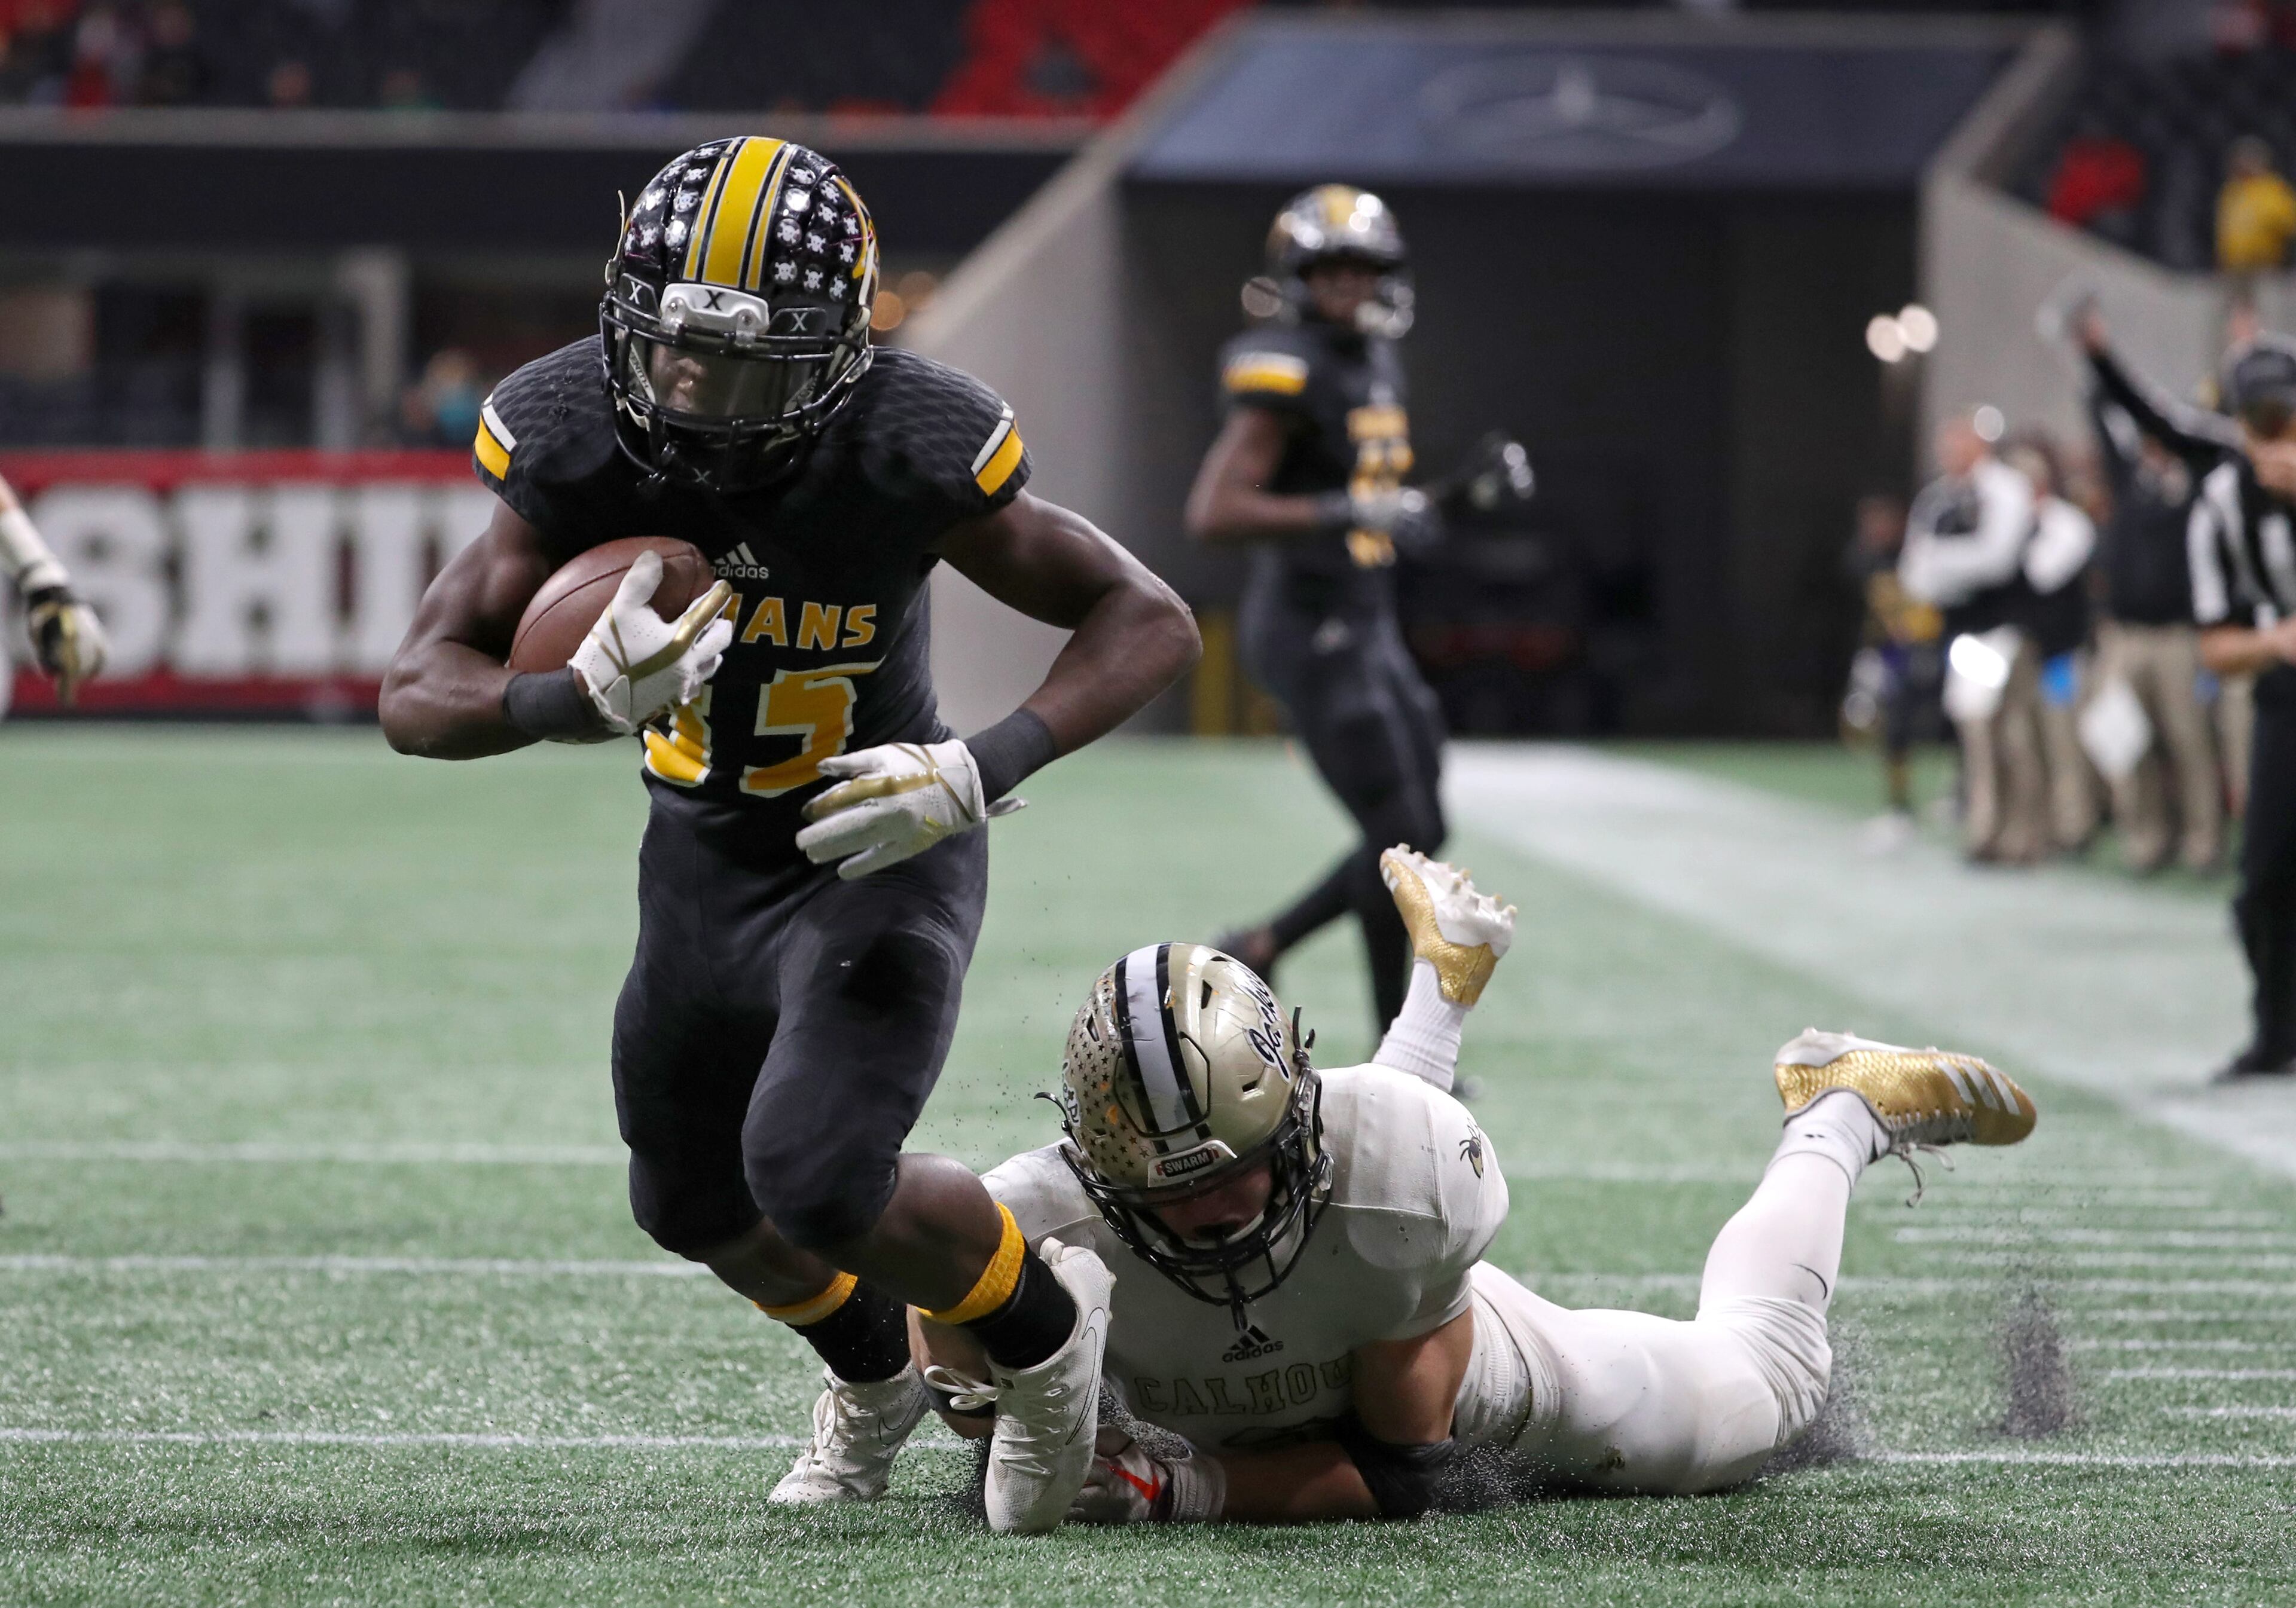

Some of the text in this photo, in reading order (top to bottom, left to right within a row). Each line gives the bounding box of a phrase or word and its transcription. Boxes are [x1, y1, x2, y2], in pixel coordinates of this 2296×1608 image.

[703, 289, 725, 311] X
[1166, 1151, 1211, 1173] SWARM
[1222, 1341, 1284, 1363] adidas
